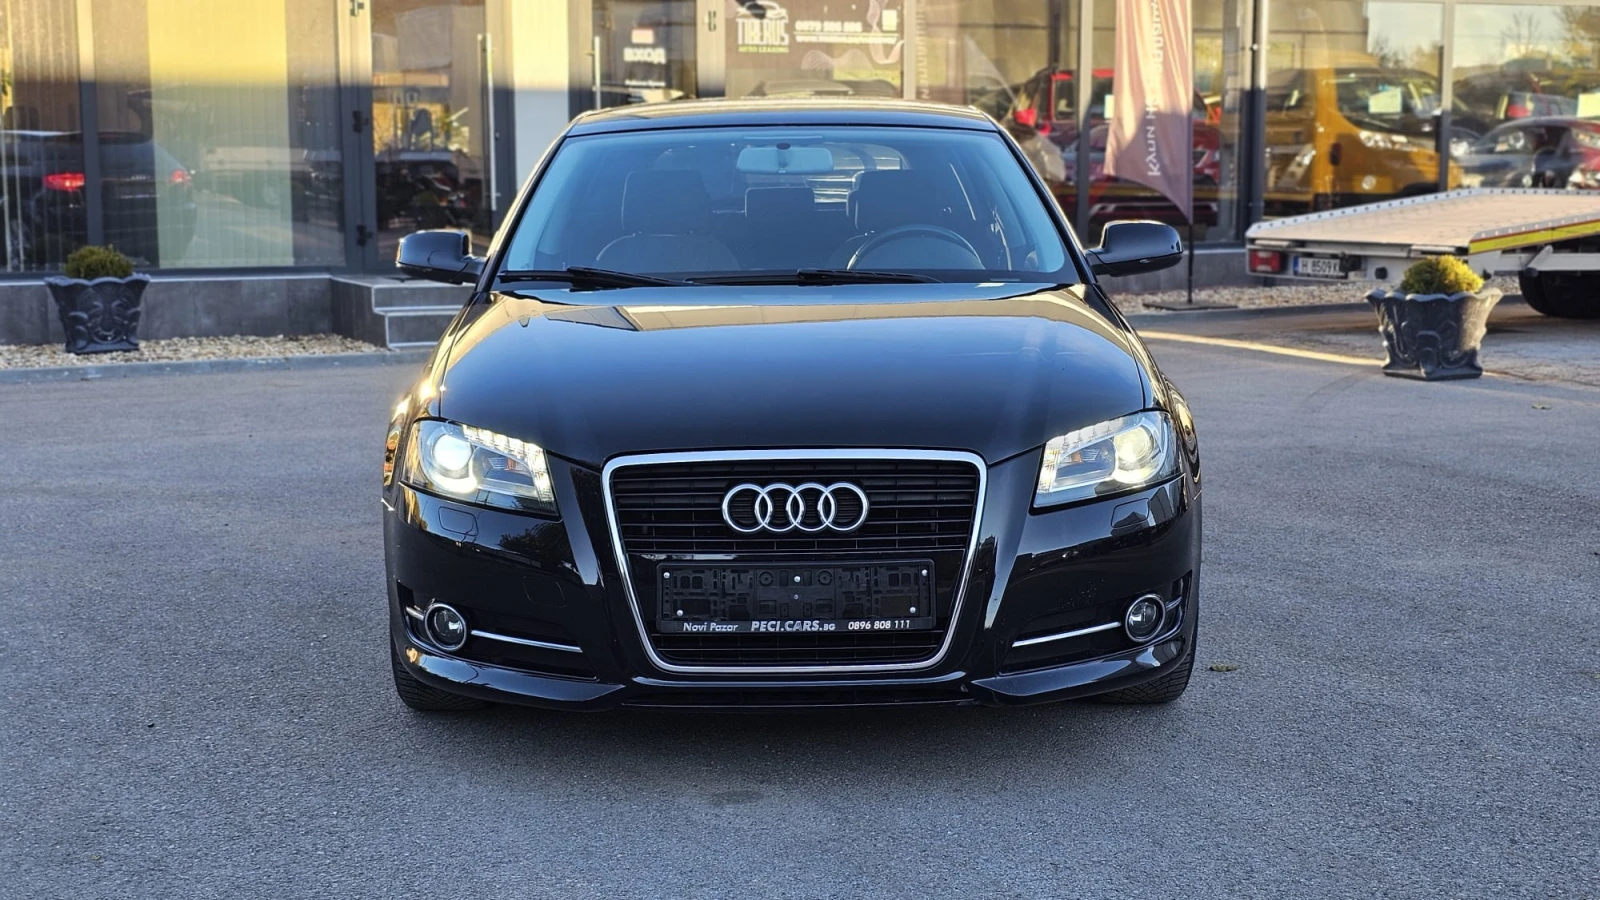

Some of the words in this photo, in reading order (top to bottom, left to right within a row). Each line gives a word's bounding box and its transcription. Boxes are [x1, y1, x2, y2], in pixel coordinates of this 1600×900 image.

[683, 622, 708, 632] Novi
[709, 622, 739, 632] Pazar
[750, 620, 836, 632] PECI.CARS.BG
[847, 621, 872, 630] 0896
[873, 620, 891, 630] 808
[894, 619, 911, 629] 111
